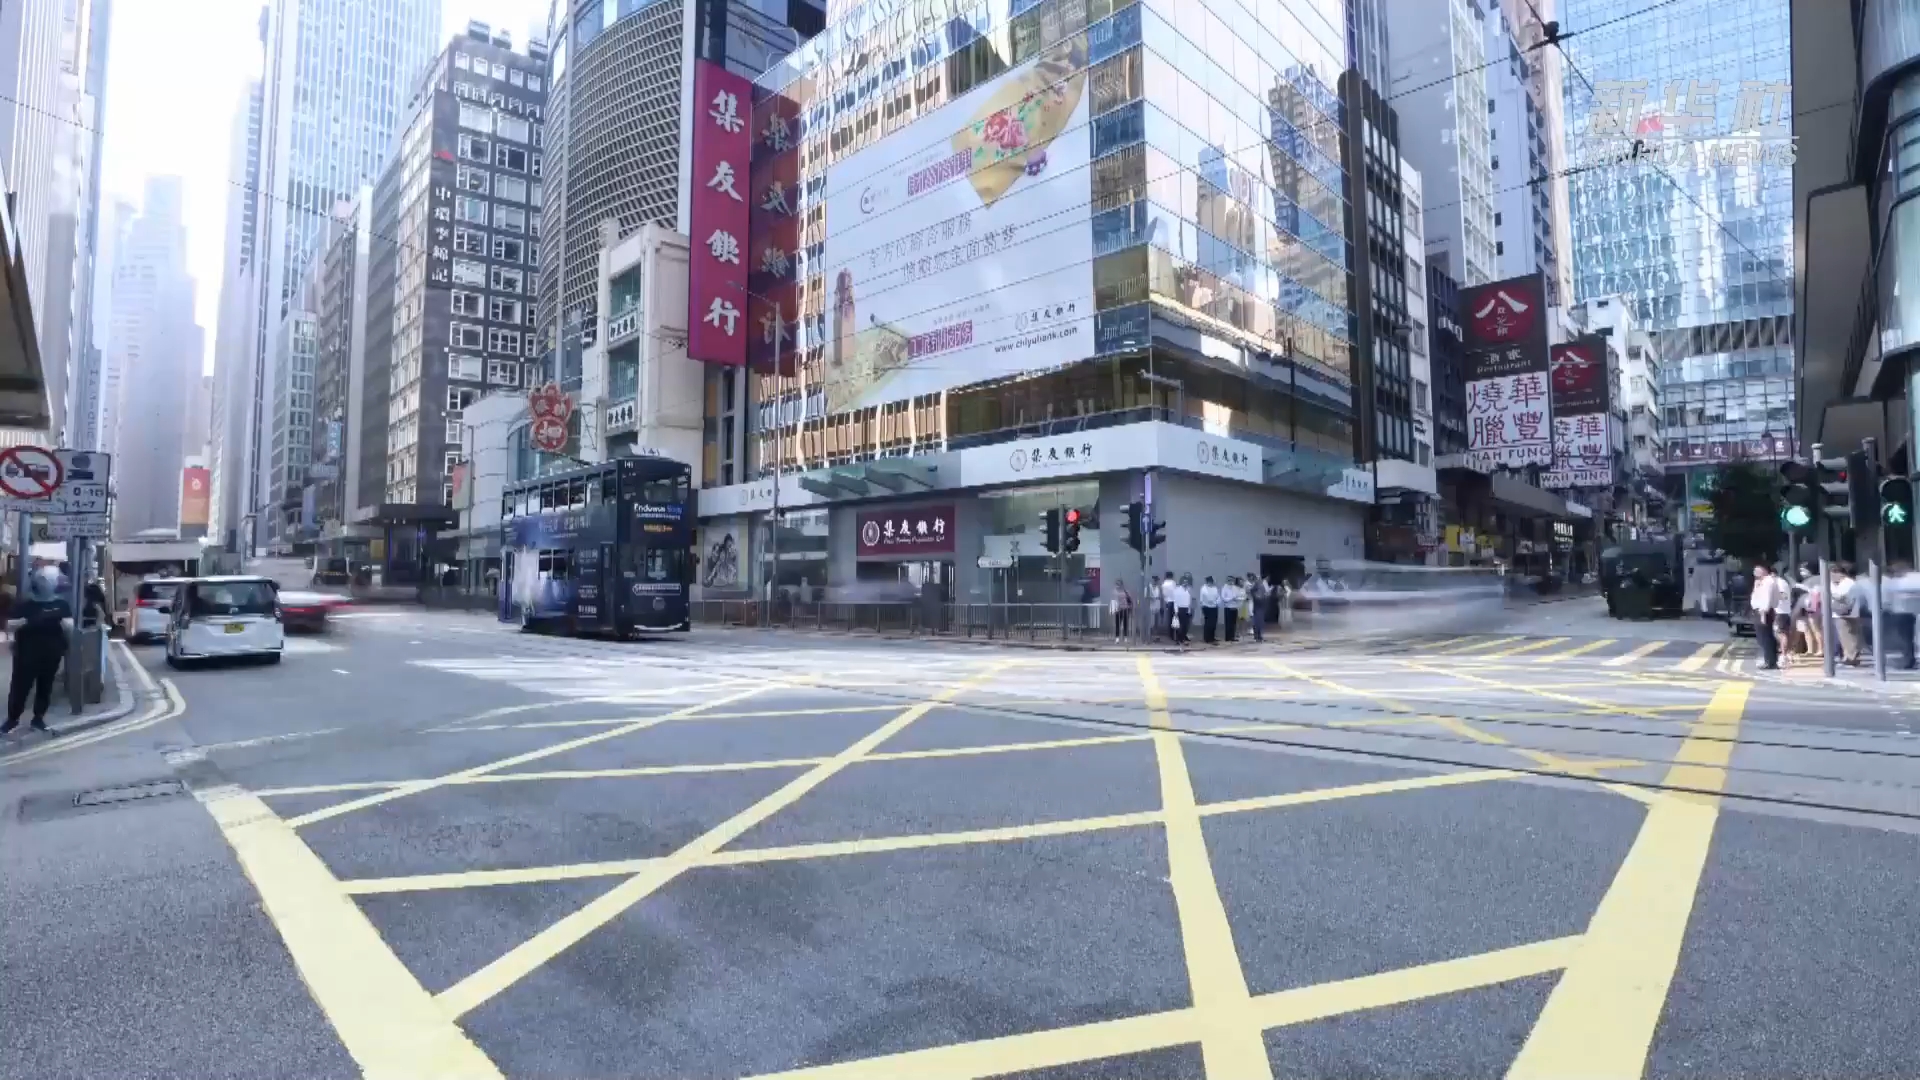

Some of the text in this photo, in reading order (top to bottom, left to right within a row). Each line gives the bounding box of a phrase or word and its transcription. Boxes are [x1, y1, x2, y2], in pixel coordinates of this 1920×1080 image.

[703, 89, 745, 336] 集友銀行
[1032, 442, 1092, 463] 集友銀行
[1211, 444, 1249, 466] 集友銀行
[883, 516, 945, 538] 集友銀行
